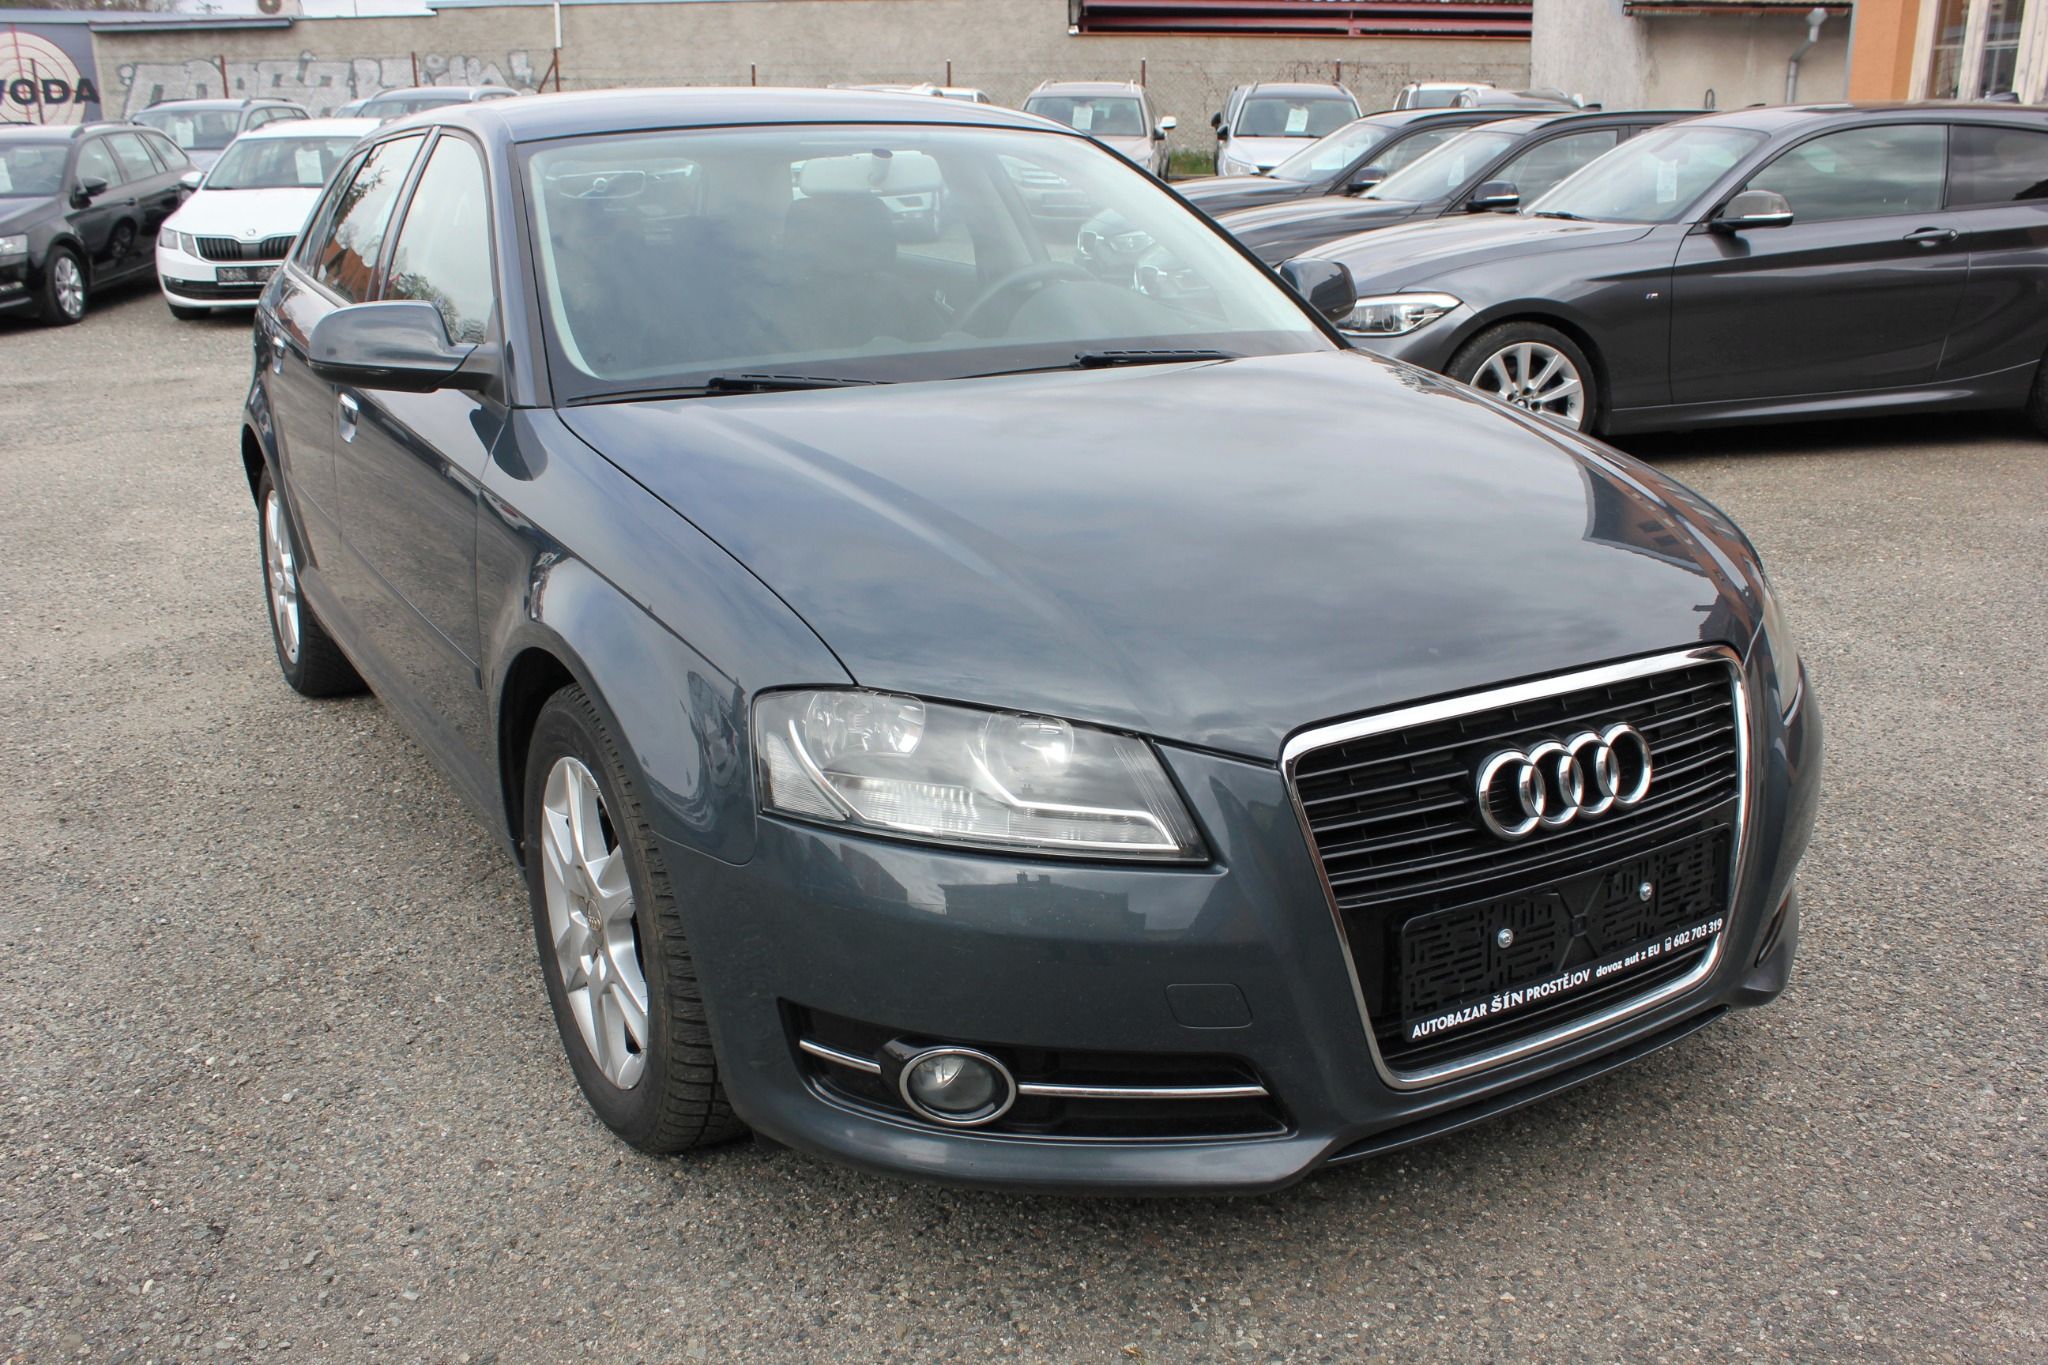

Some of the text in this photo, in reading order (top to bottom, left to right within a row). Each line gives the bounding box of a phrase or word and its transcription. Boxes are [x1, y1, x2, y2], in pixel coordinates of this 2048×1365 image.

[0, 78, 100, 105] ODA
[1411, 918, 1723, 1038] AUTOBAZAR ŠÍN PROSTĚJOV dovoz aut z EU 602 703 319
